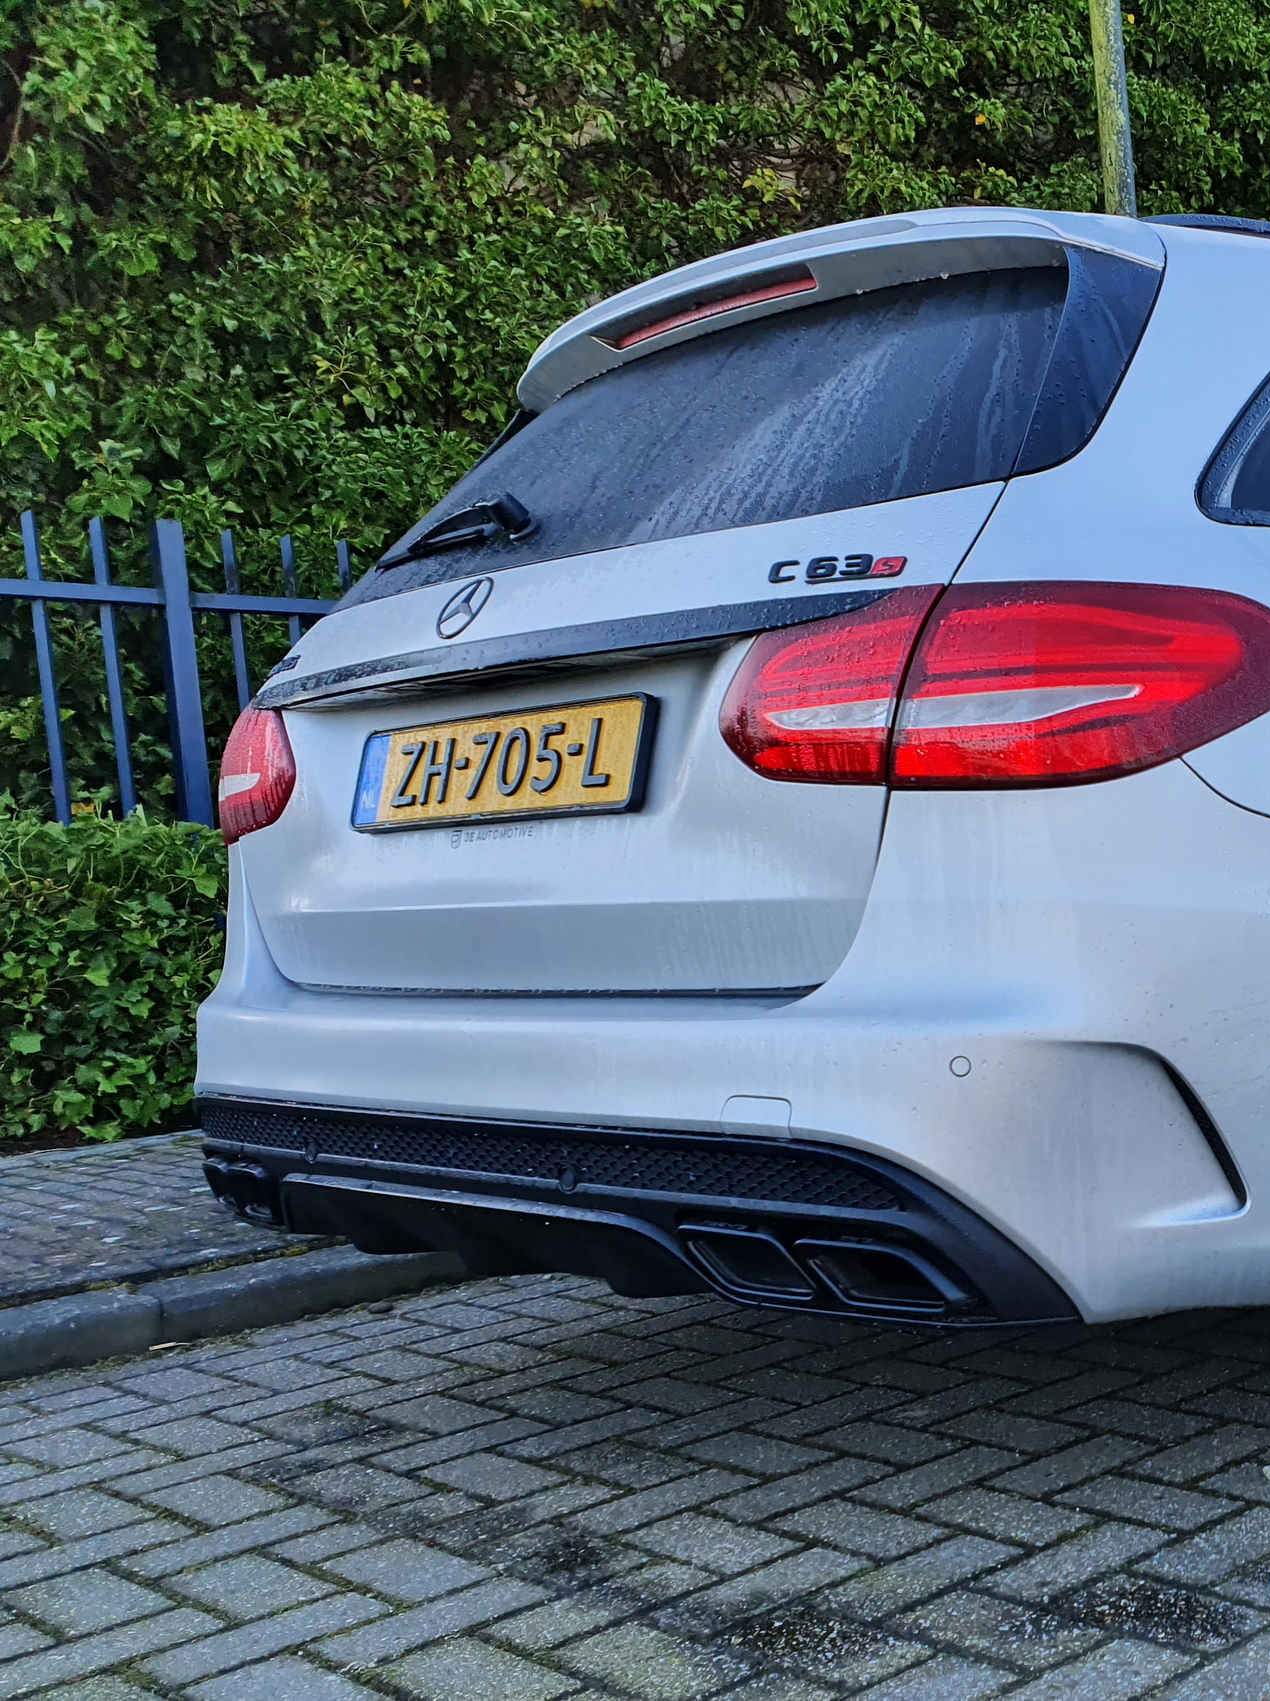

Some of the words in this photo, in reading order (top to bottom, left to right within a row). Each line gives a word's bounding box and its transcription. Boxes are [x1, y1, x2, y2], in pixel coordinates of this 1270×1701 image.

[768, 559, 801, 584] C
[390, 717, 611, 808] ZH-705-L
[476, 825, 533, 842] AUTOMOTIVE
